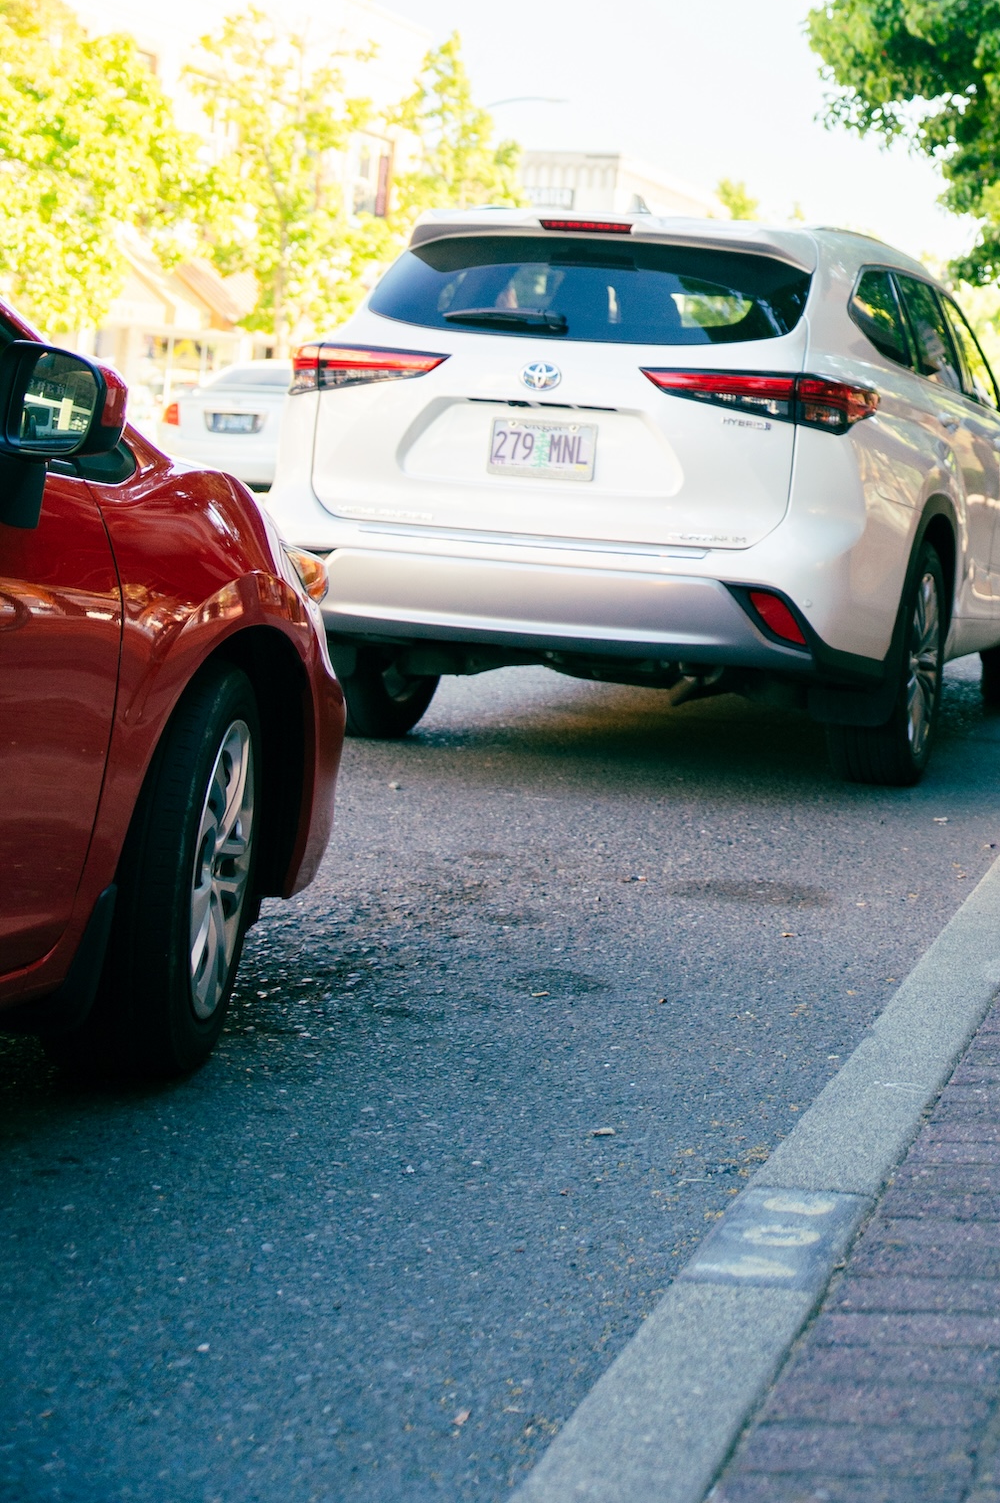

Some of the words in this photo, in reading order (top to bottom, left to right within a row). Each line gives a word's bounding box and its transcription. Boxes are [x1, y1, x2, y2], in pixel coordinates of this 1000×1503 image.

[721, 417, 765, 429] HYBRID
[494, 431, 535, 460] 279
[548, 434, 588, 465] MNL
